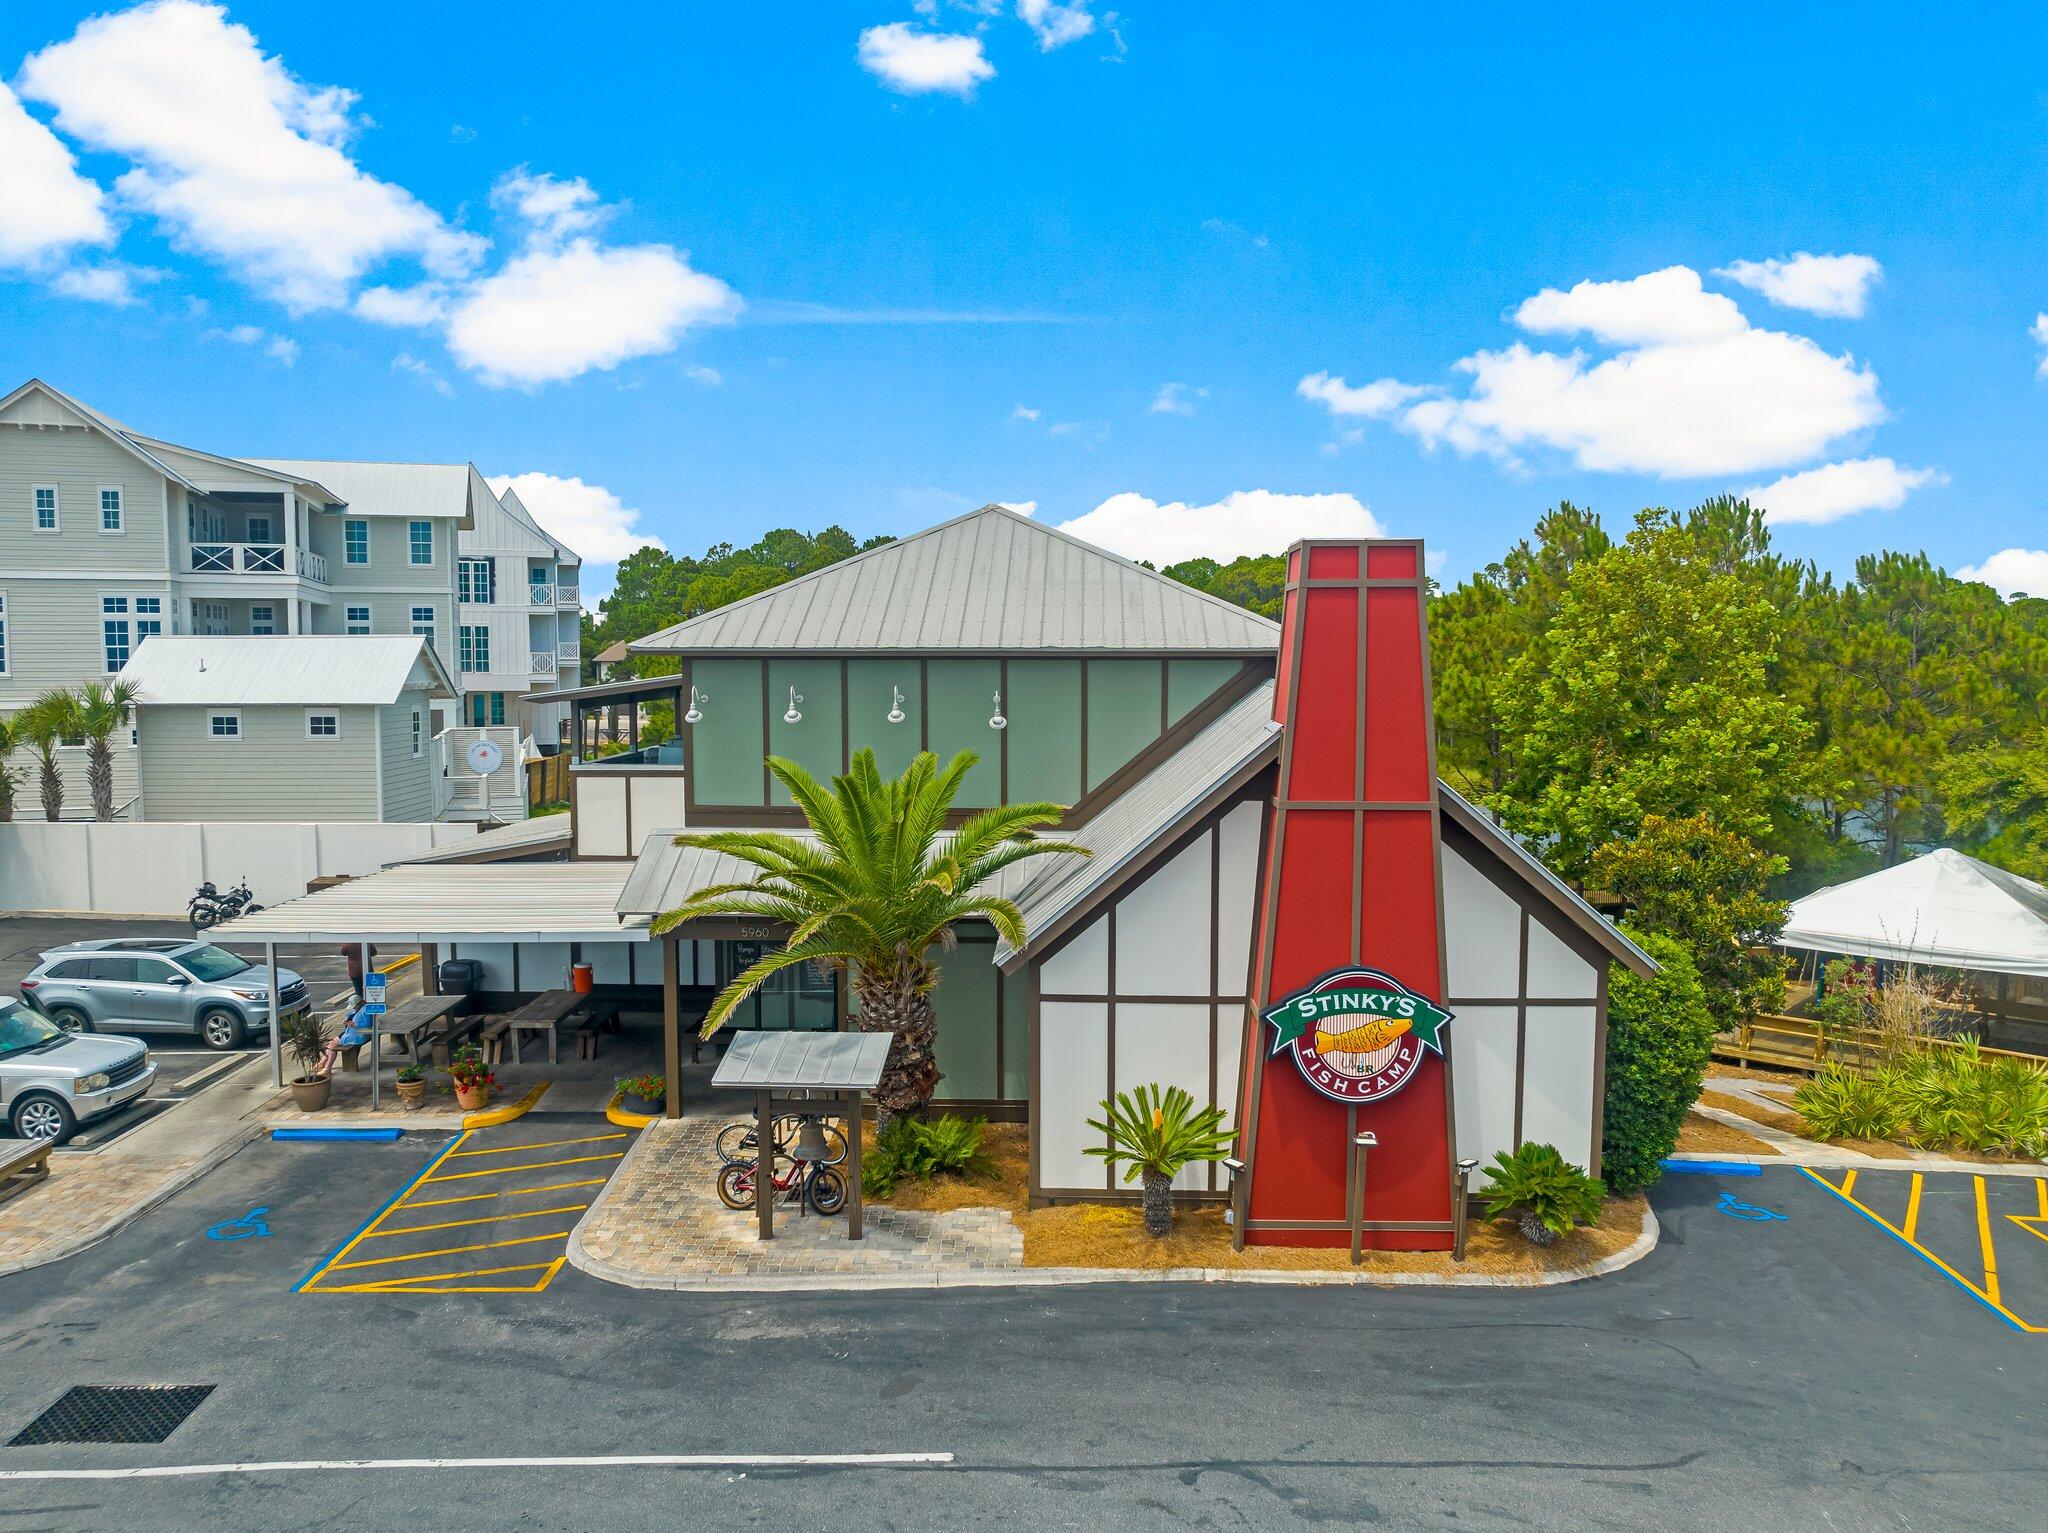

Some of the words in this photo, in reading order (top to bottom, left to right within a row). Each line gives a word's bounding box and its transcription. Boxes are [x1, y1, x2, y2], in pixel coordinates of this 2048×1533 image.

[741, 926, 770, 938] 5960
[1298, 993, 1417, 1018] STINKY'S
[1301, 1047, 1349, 1093] FISH
[1357, 1047, 1412, 1094] CAMP
